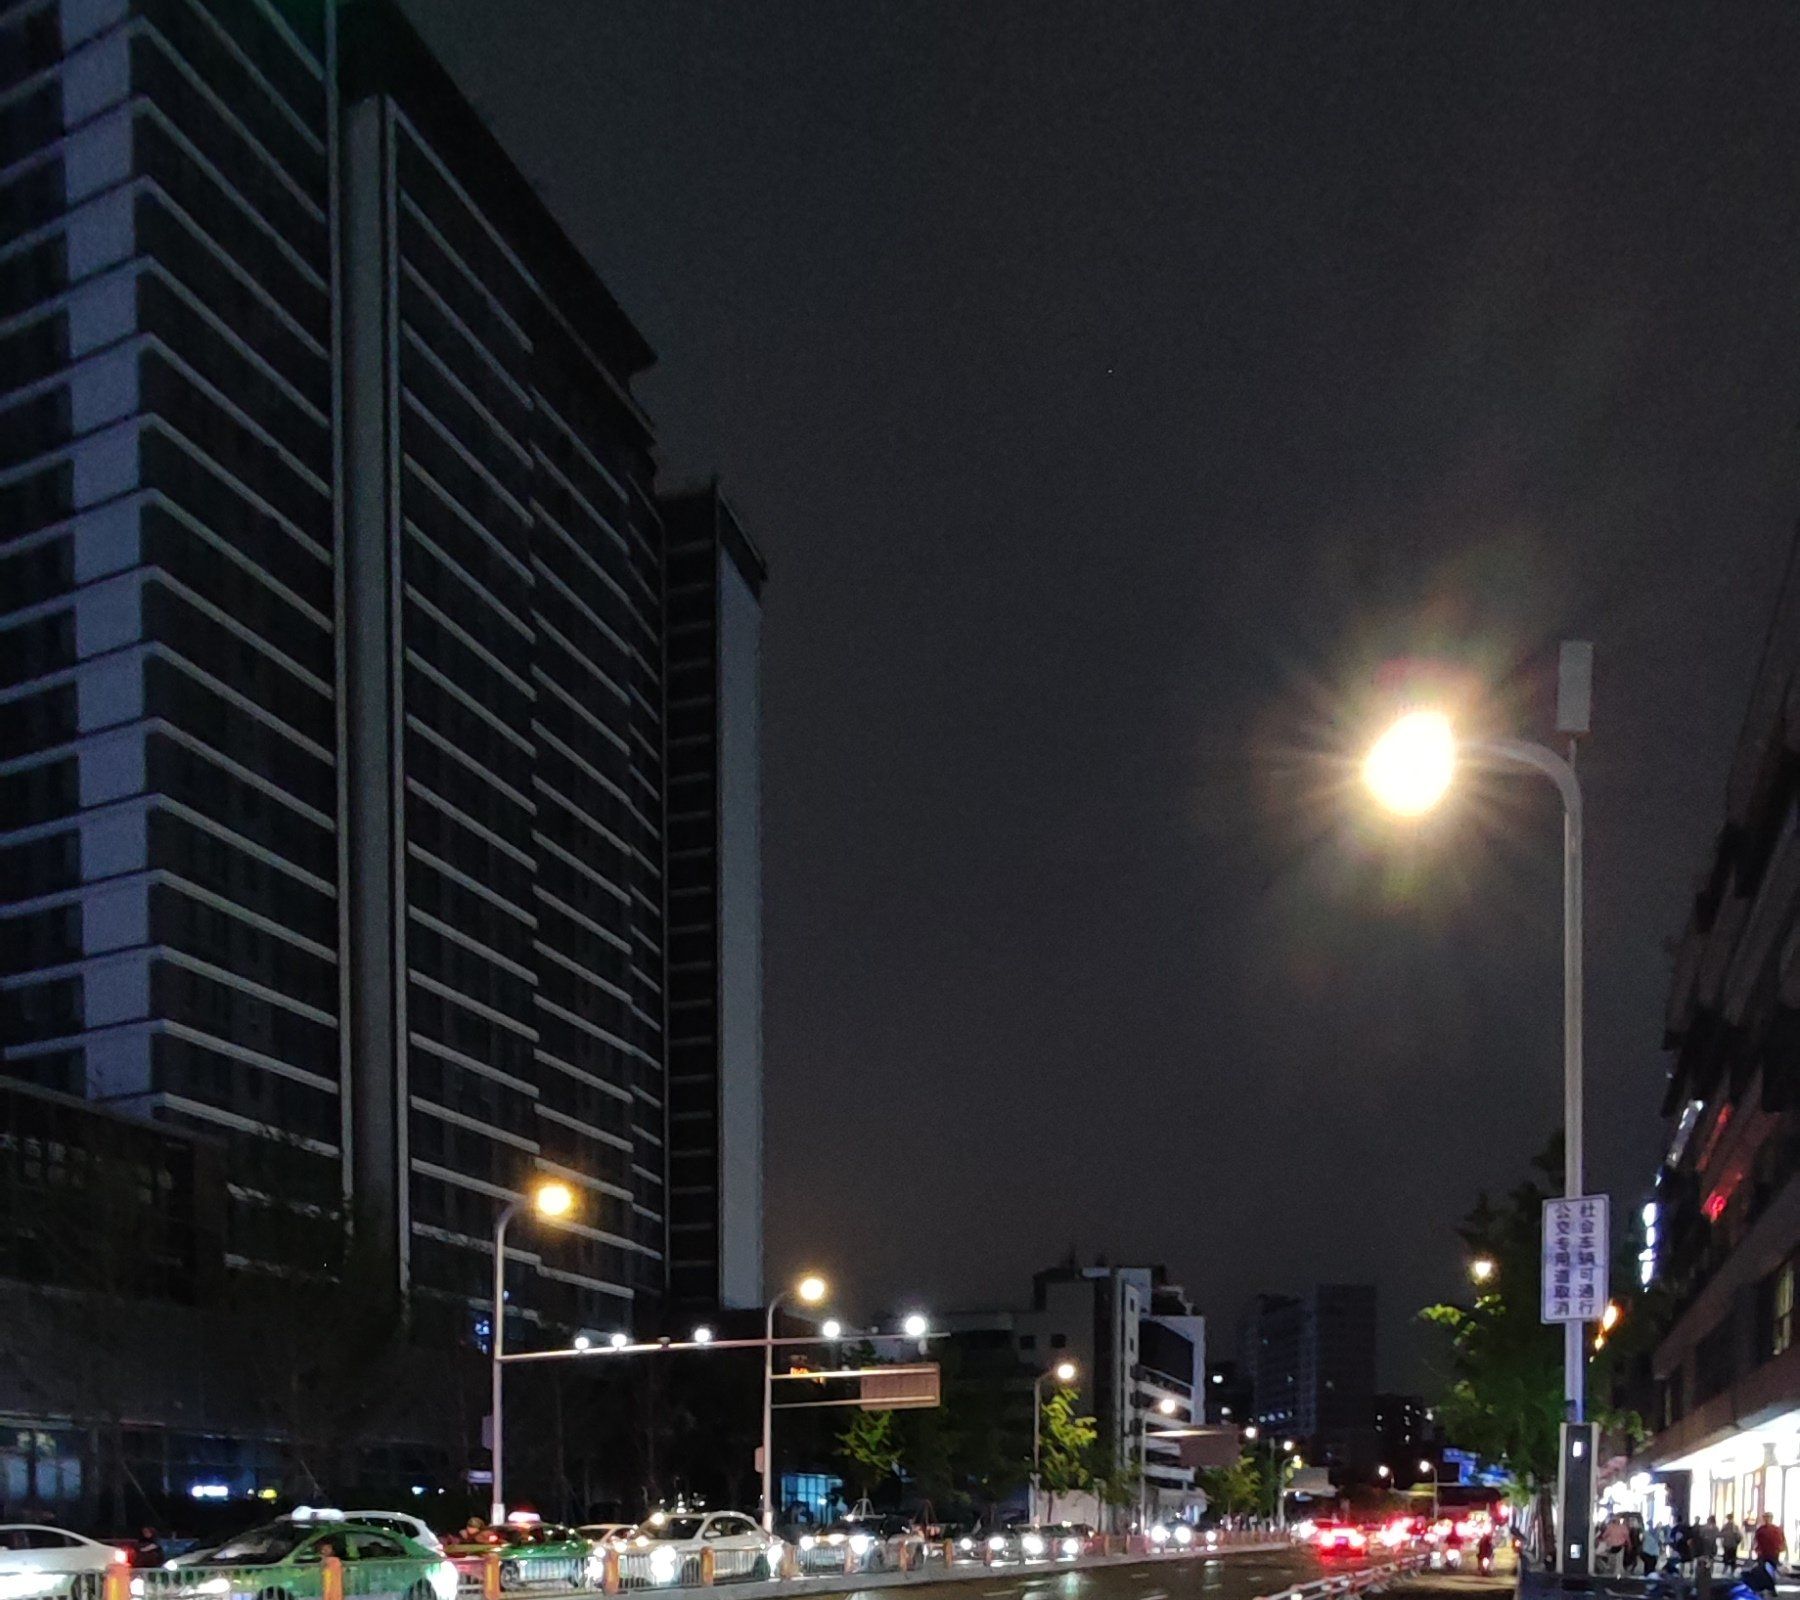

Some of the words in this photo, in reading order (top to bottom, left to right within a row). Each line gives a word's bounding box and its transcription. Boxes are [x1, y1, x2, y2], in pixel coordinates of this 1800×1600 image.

[1554, 1203, 1571, 1316] 公交专用道取消
[1578, 1202, 1596, 1314] 社会车辆可通行
